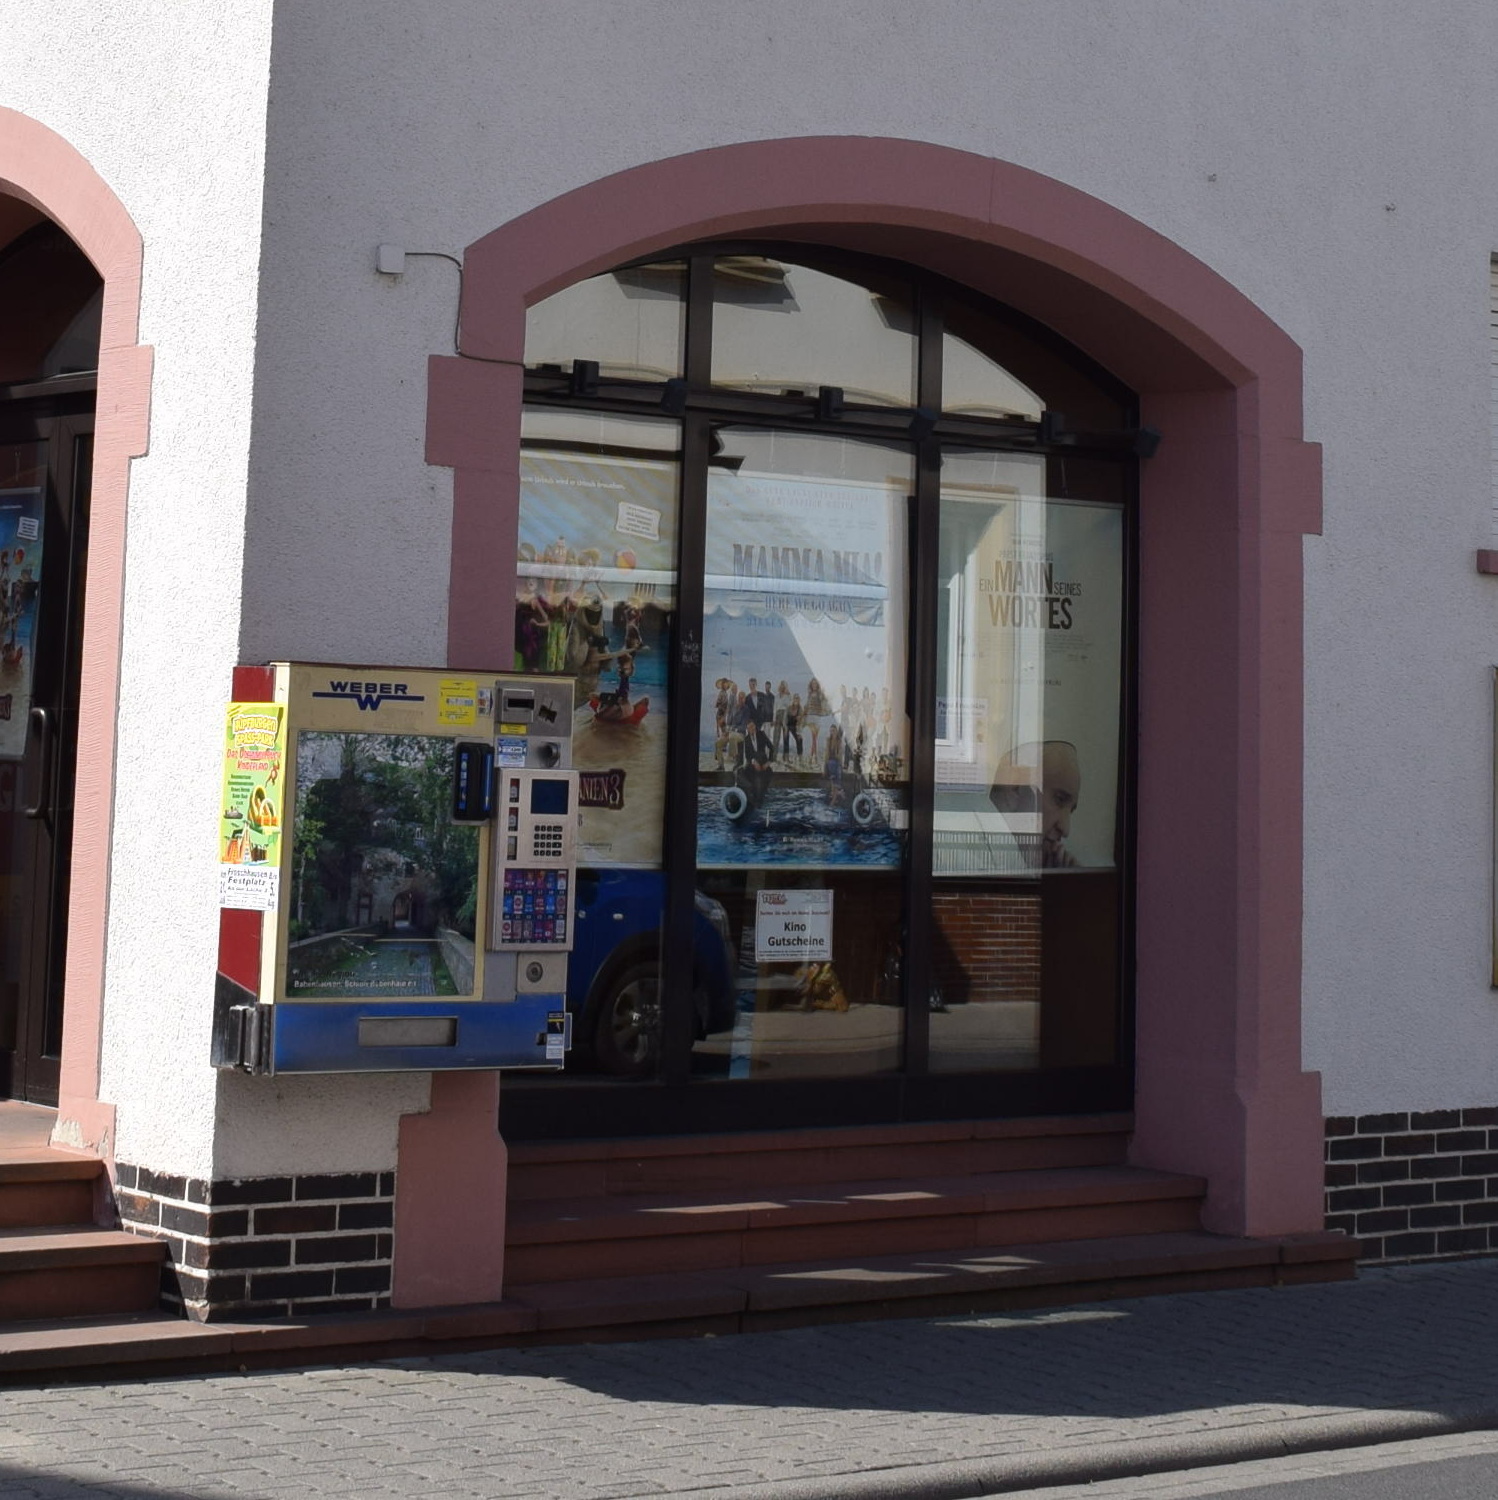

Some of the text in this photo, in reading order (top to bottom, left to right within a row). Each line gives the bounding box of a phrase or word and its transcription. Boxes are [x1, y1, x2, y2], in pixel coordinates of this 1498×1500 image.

[980, 560, 1082, 597] EIN MANN SEINES
[989, 594, 1073, 630] WORTES
[330, 681, 408, 694] WEBER
[228, 876, 266, 887] Festplatz
[784, 921, 806, 932] Kino
[767, 935, 825, 947] Gutscheine
